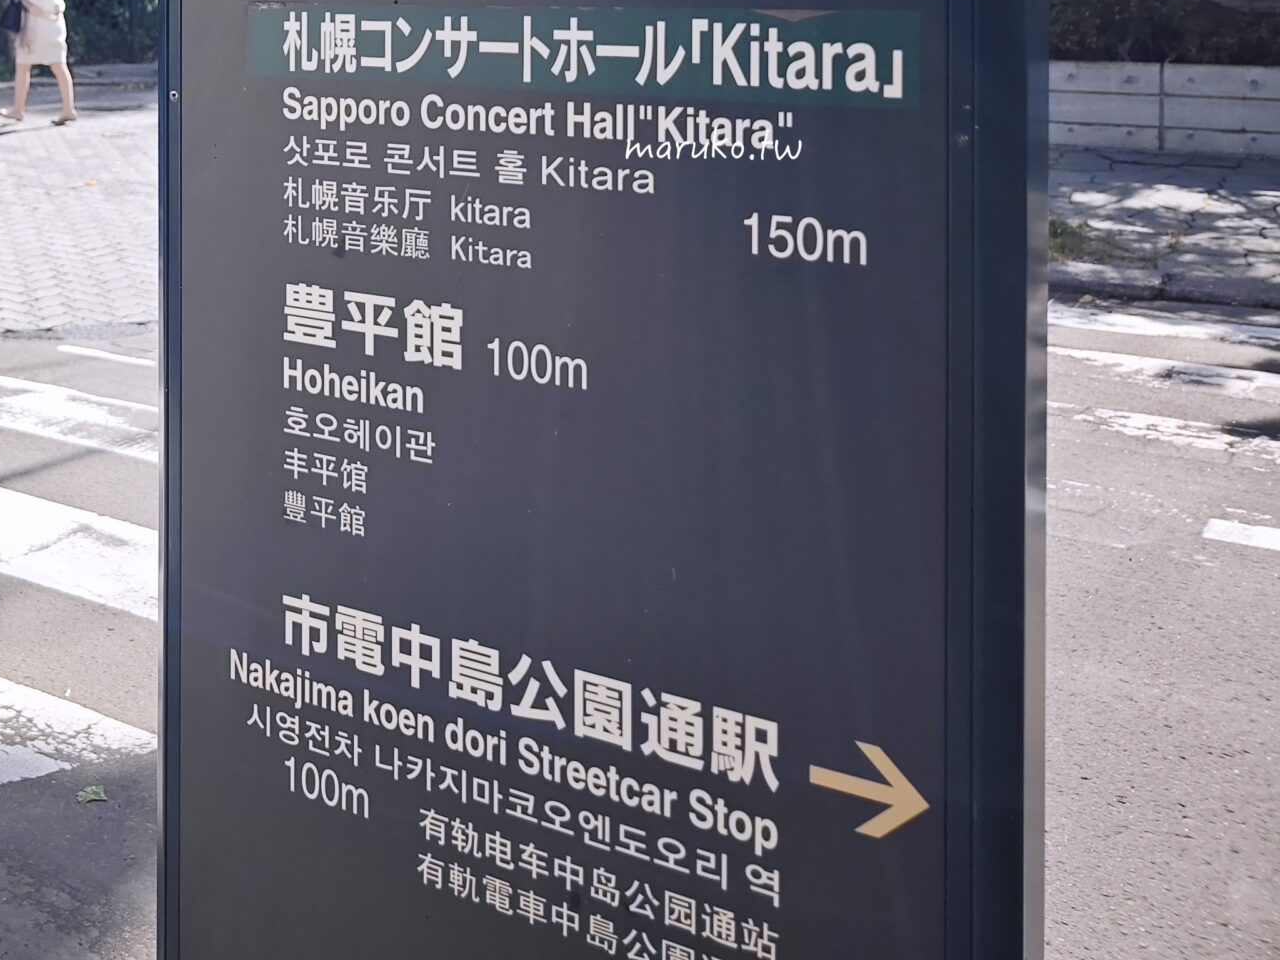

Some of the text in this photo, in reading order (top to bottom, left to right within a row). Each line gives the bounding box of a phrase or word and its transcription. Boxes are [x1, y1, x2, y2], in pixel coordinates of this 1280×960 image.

[282, 86, 411, 132] Sapporo
[420, 93, 555, 137] Concert
[282, 135, 655, 194] 삿포로 콘서트 홀 Kitara
[283, 175, 531, 229] 札幌音乐厅 kitara
[283, 213, 532, 269] 札幌音樂廳 Kitara
[743, 212, 867, 266] 150m
[283, 282, 588, 391] 豊平館 100m
[283, 356, 424, 414] Hoheikan
[283, 405, 436, 464] 호오헤이관
[283, 447, 368, 494] 丰平馆
[282, 593, 780, 793] 市電中島公園通駅
[230, 647, 778, 857] Nakajima koen dori Streetcar Stop
[246, 703, 780, 908] 시영전차 나카지마코오엔도오리 역
[284, 756, 369, 819] 100m
[418, 808, 780, 960] 有轨电车中岛公园通站
